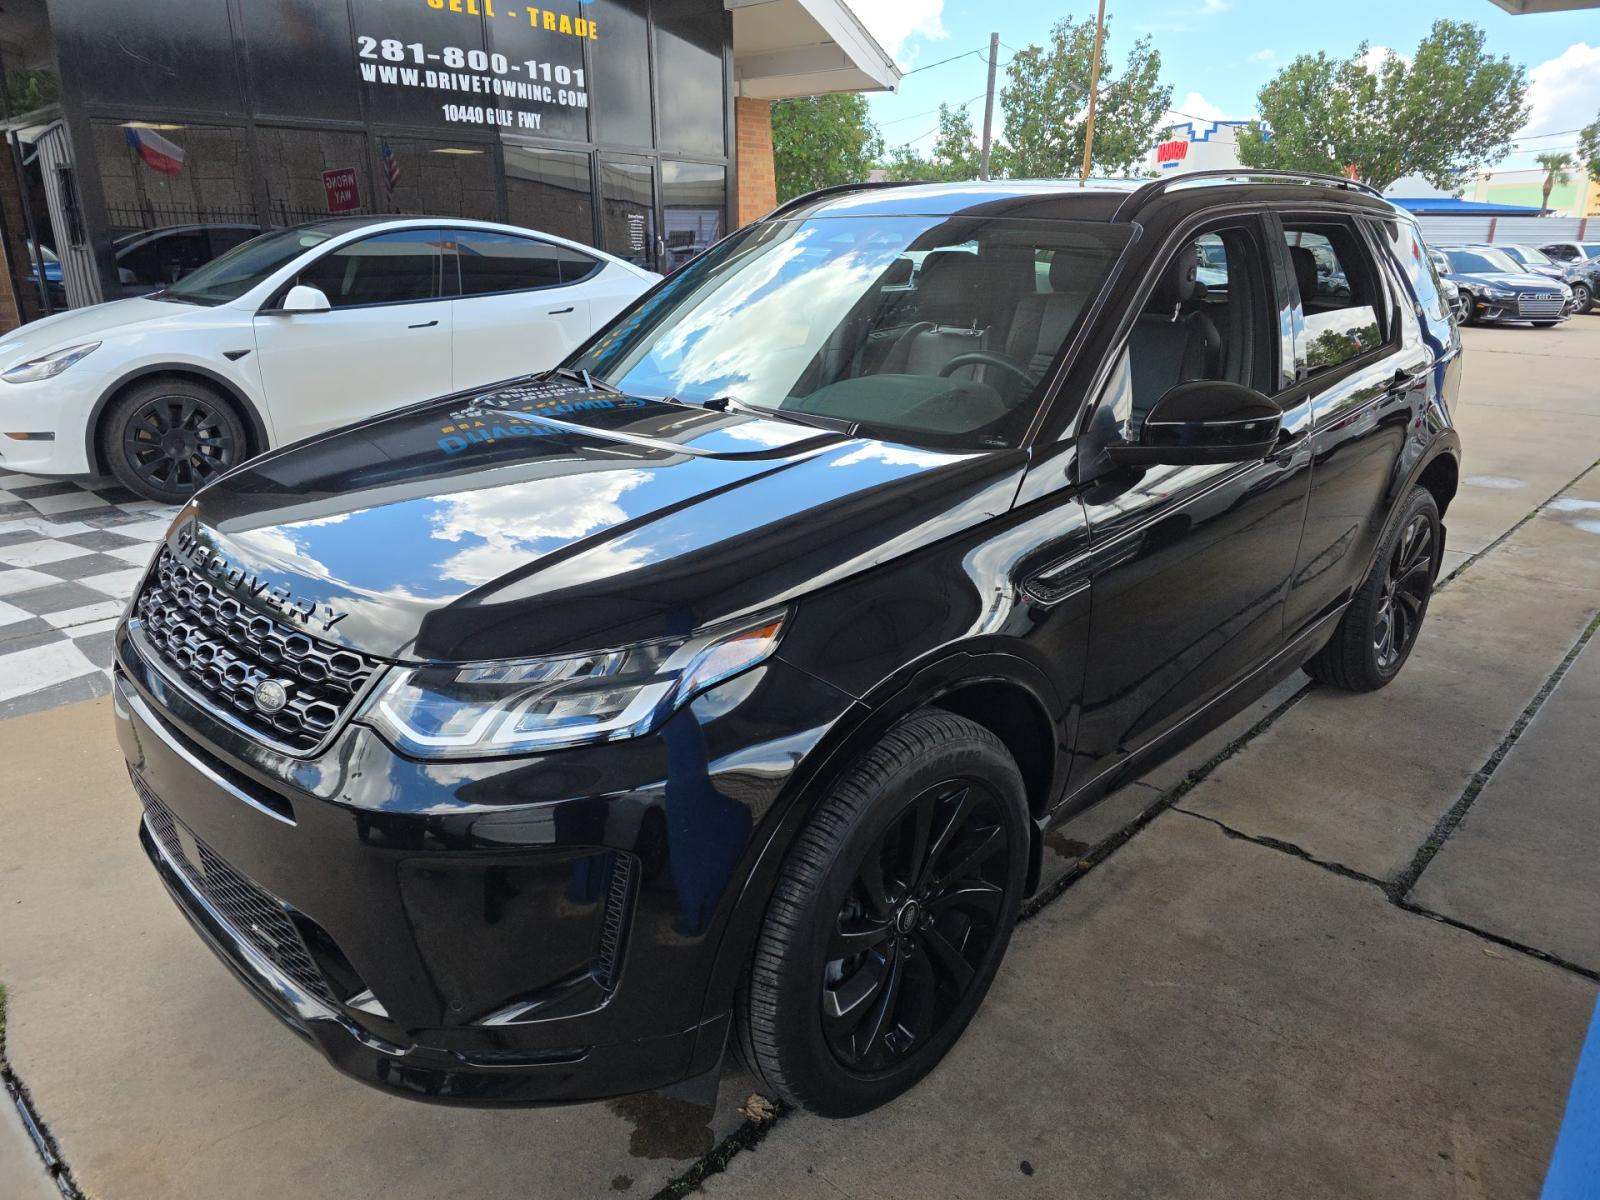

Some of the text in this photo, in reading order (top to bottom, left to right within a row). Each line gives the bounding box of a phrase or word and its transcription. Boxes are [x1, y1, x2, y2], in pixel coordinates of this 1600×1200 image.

[527, 7, 598, 40] TRADE
[357, 36, 585, 87] 281-800-1101
[360, 63, 588, 108] WWW.DRIVETOWNINC.COM
[442, 104, 542, 129] 10440 GULF FWY
